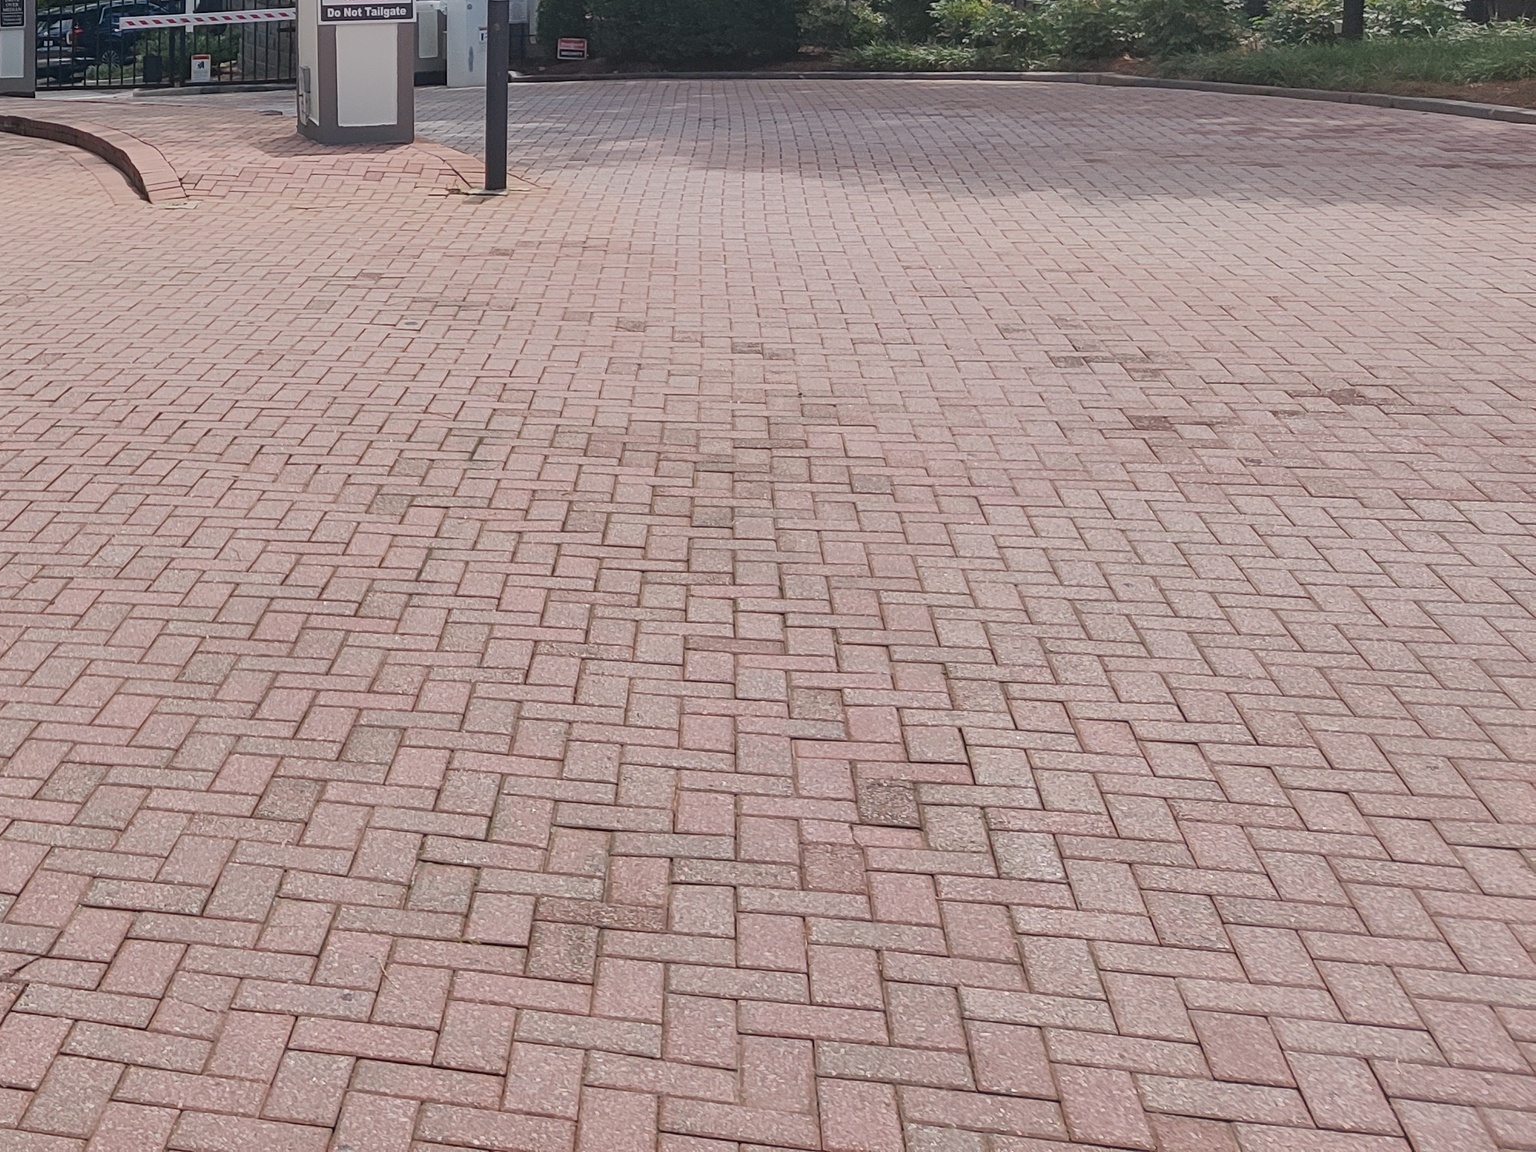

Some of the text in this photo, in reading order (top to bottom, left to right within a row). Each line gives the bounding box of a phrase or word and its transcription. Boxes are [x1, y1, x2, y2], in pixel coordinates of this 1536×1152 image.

[327, 6, 406, 18] Do Not Tailgate
